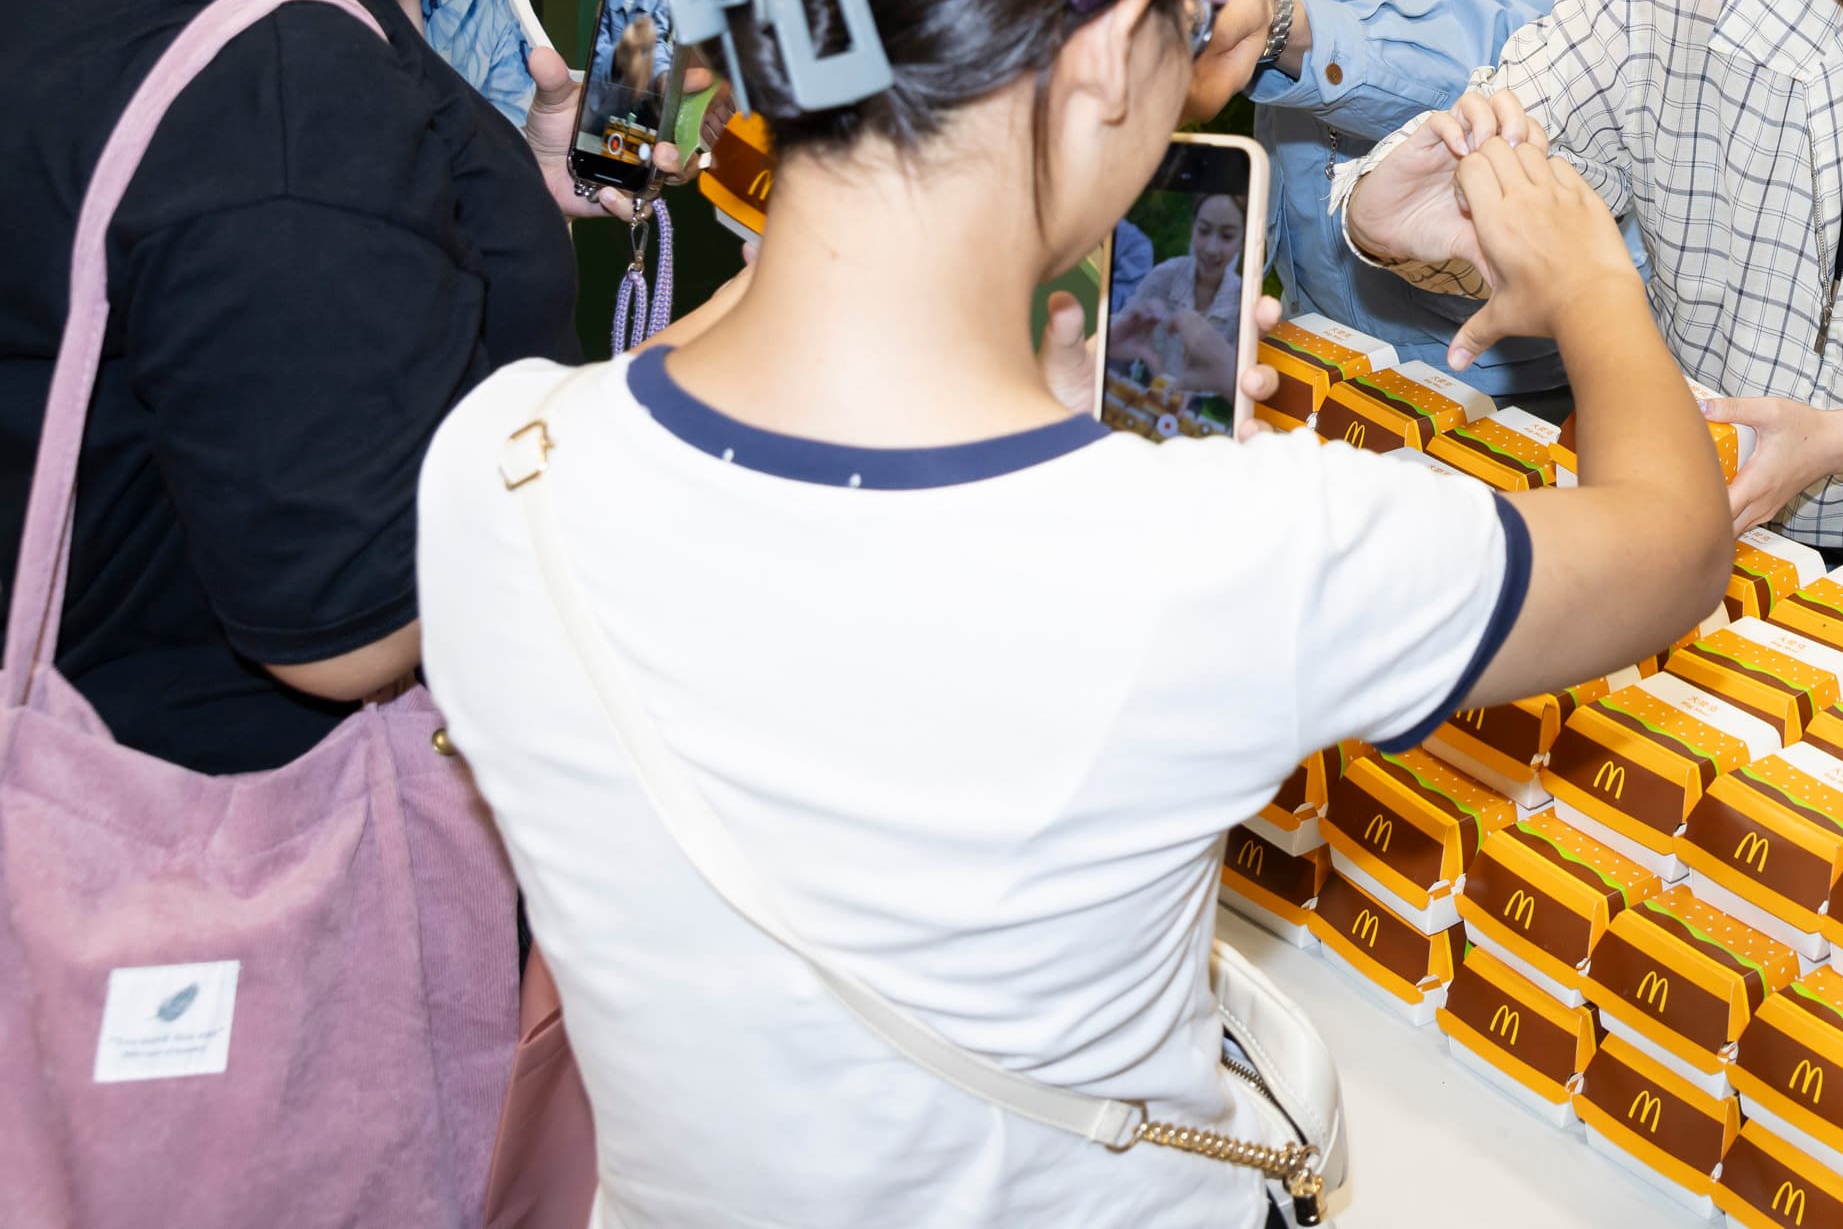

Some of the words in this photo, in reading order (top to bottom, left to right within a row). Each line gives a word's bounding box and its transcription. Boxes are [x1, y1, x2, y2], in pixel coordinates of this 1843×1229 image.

[1593, 760, 1626, 800] M
[1365, 814, 1392, 853] M
[1734, 831, 1770, 873] M
[1237, 839, 1264, 875] M
[1352, 908, 1379, 948] M
[1504, 889, 1535, 930] M
[1636, 970, 1669, 1013] M
[1490, 1004, 1520, 1045] M
[1789, 1059, 1824, 1104] M
[1628, 1090, 1662, 1133] M
[1772, 1180, 1806, 1227] M
